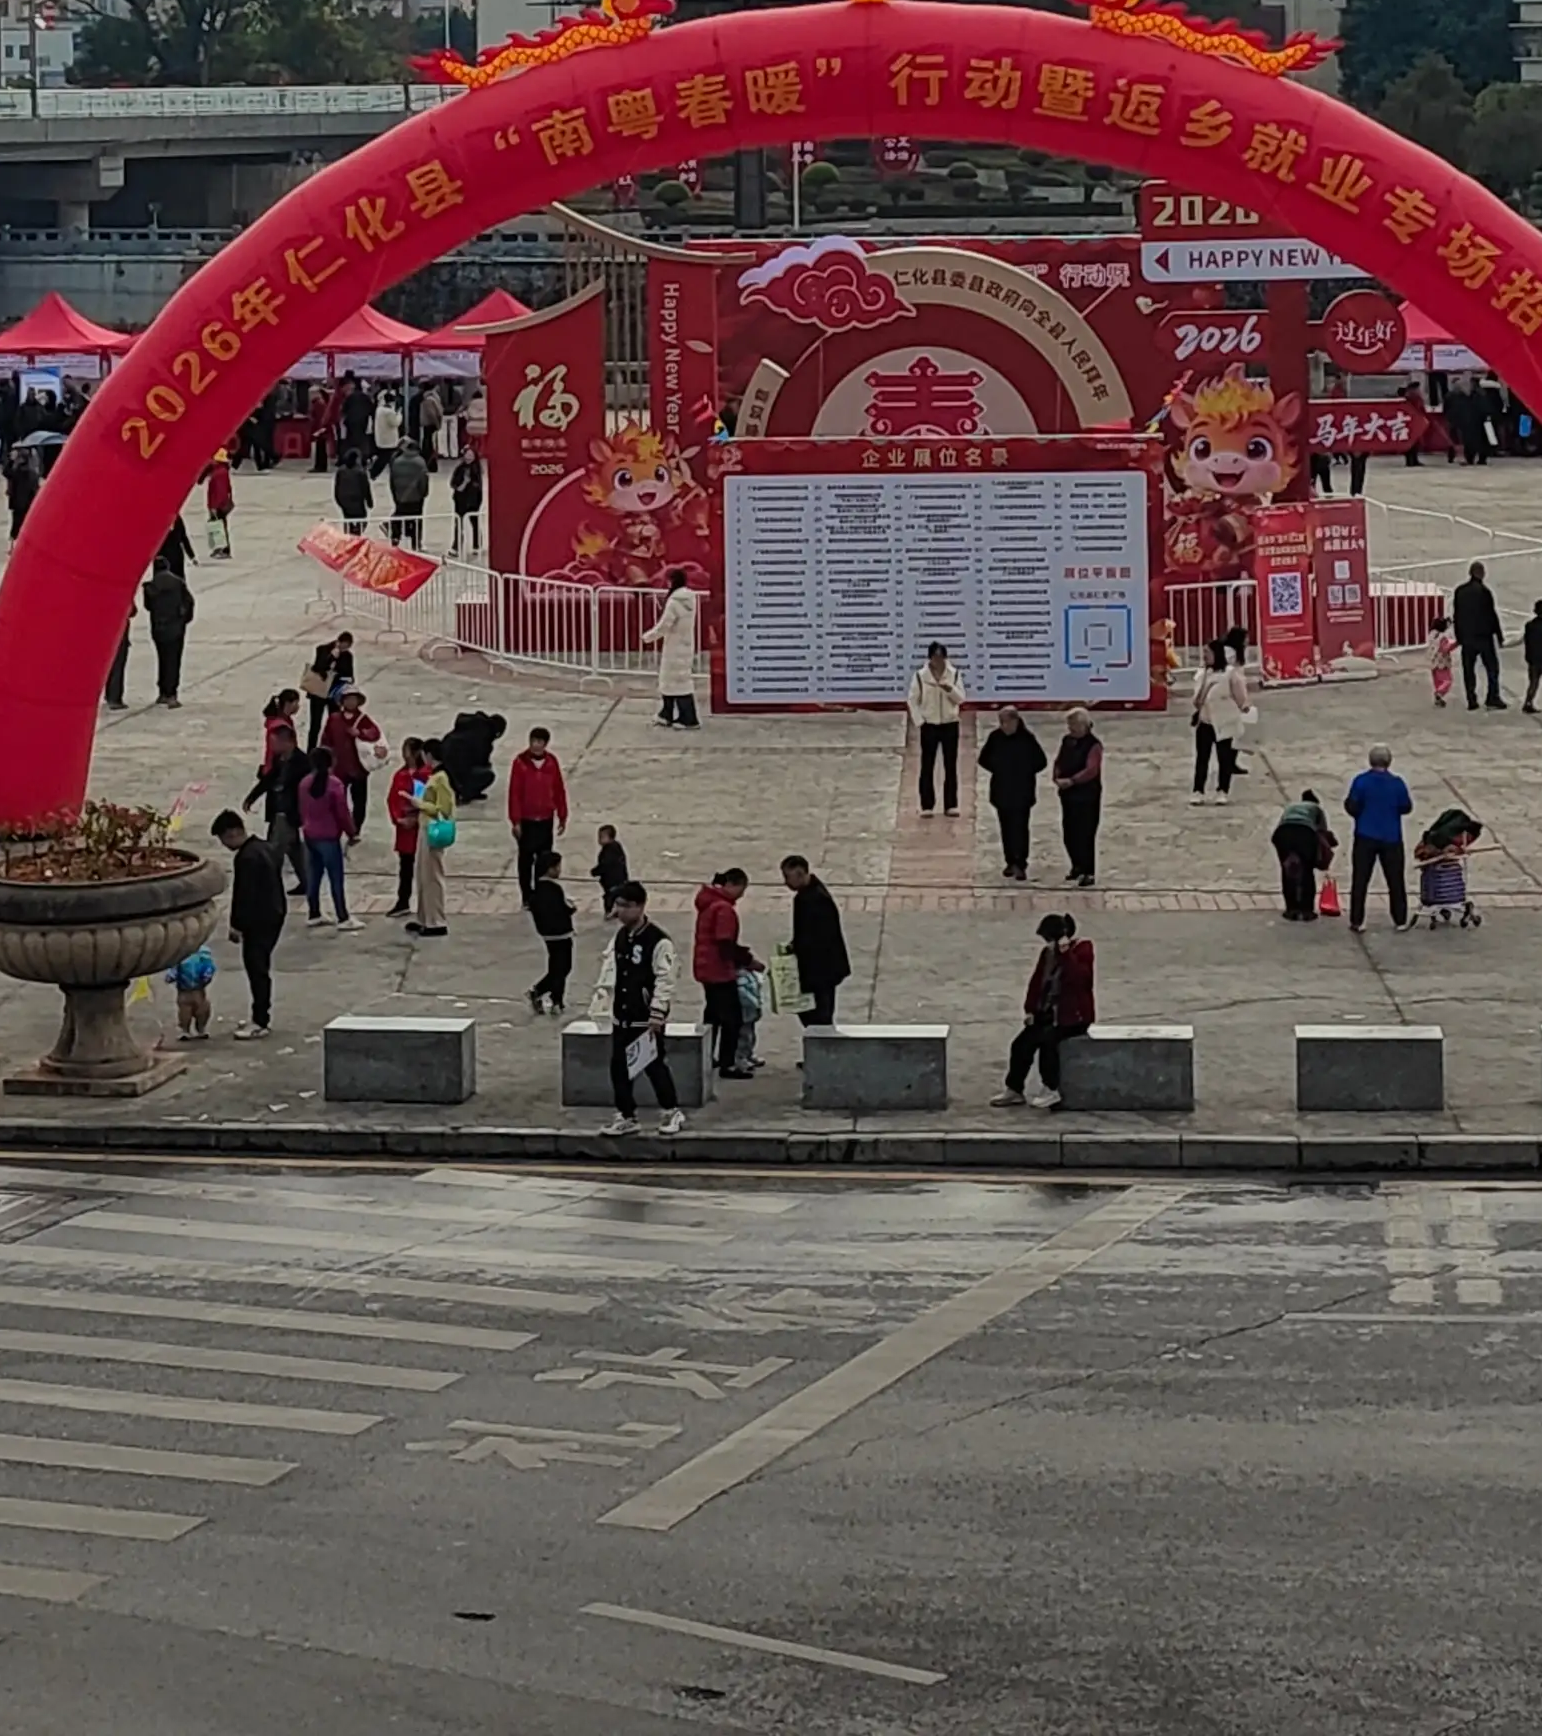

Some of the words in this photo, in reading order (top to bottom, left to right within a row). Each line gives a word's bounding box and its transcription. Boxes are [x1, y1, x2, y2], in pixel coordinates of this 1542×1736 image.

[1188, 250, 1264, 269] HAPPY
[1268, 248, 1321, 267] NEW
[660, 283, 680, 347] Happy
[1330, 319, 1398, 347] 过年好
[1174, 316, 1262, 361] 2026
[664, 348, 680, 389] New
[513, 364, 580, 432] 福
[665, 390, 680, 434] Year
[1309, 411, 1412, 448] 马年大吉
[631, 943, 644, 965] S
